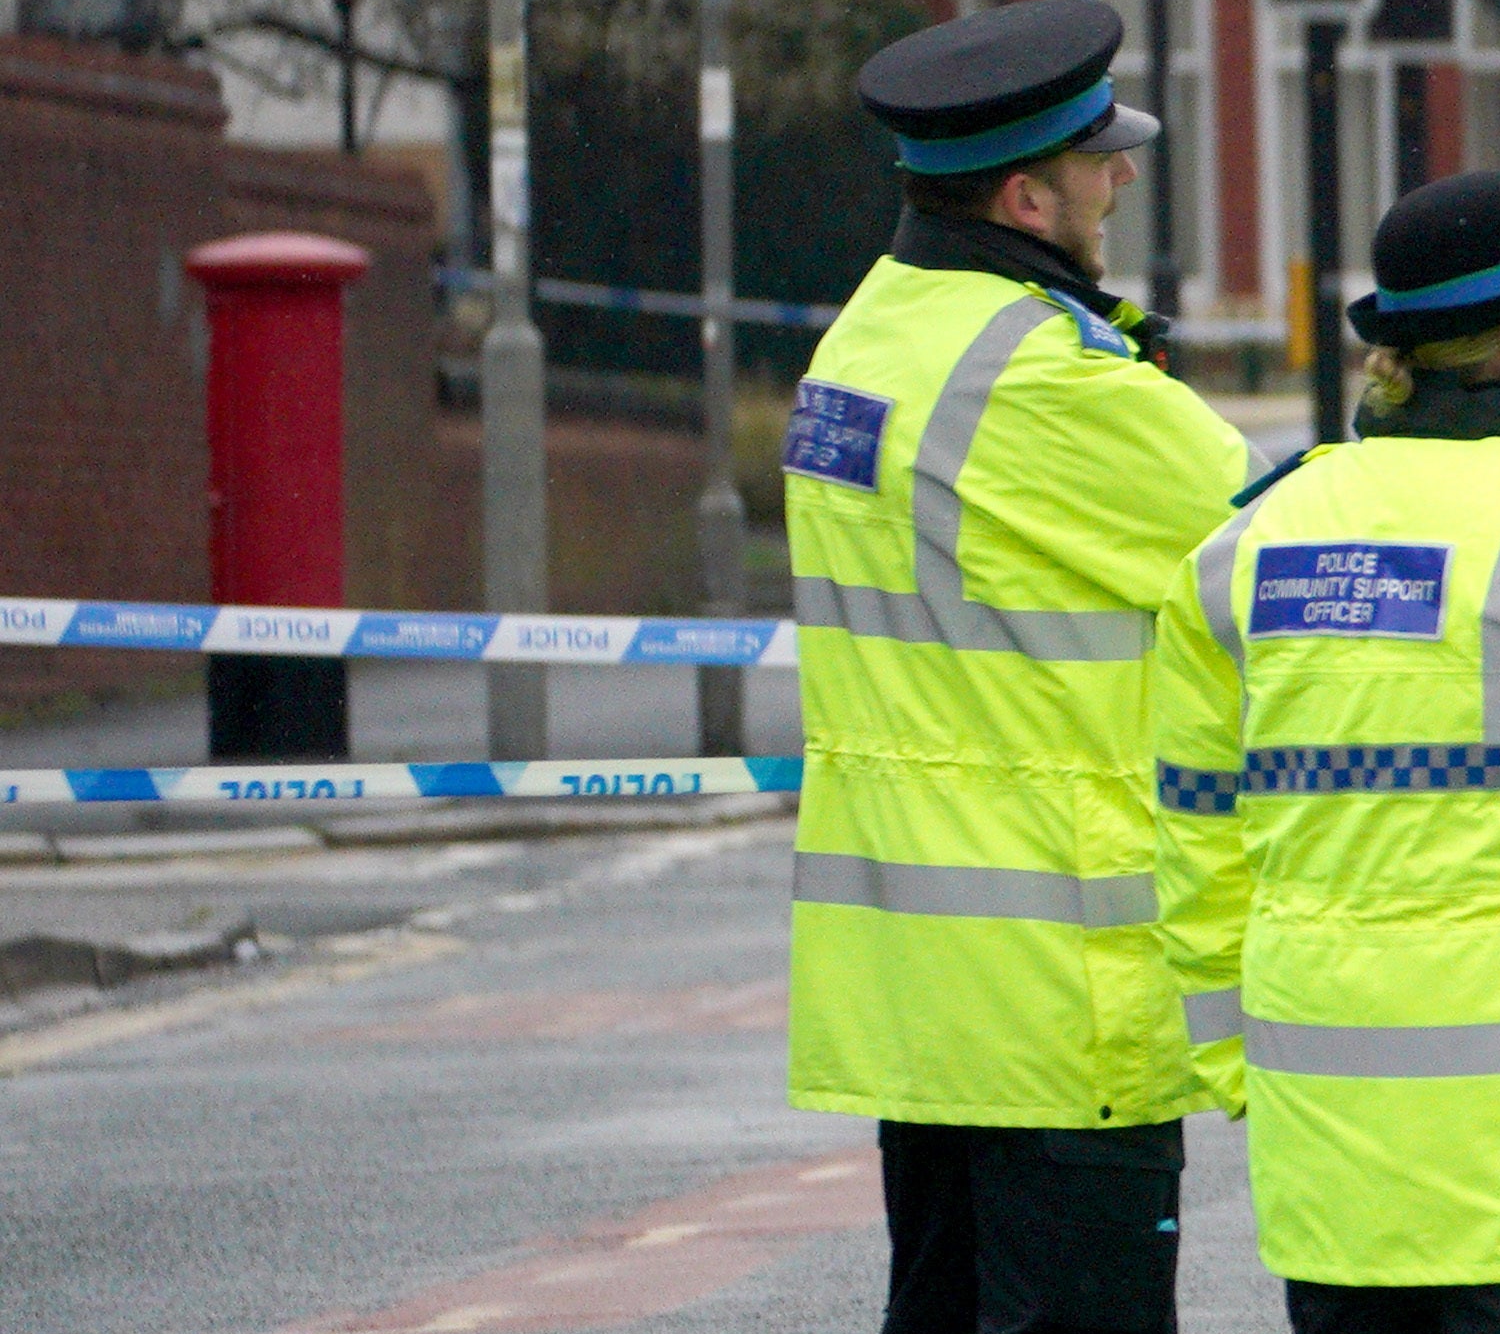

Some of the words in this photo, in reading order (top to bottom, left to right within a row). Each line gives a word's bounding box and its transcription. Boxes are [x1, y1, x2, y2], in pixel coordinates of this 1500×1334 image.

[1316, 552, 1379, 574] POLICE
[1258, 577, 1350, 601] COMMUNITY
[1352, 577, 1437, 601] SUPPORT
[1303, 600, 1374, 623] OFFICER
[238, 616, 330, 641] POLICE
[518, 623, 609, 649] POLICE
